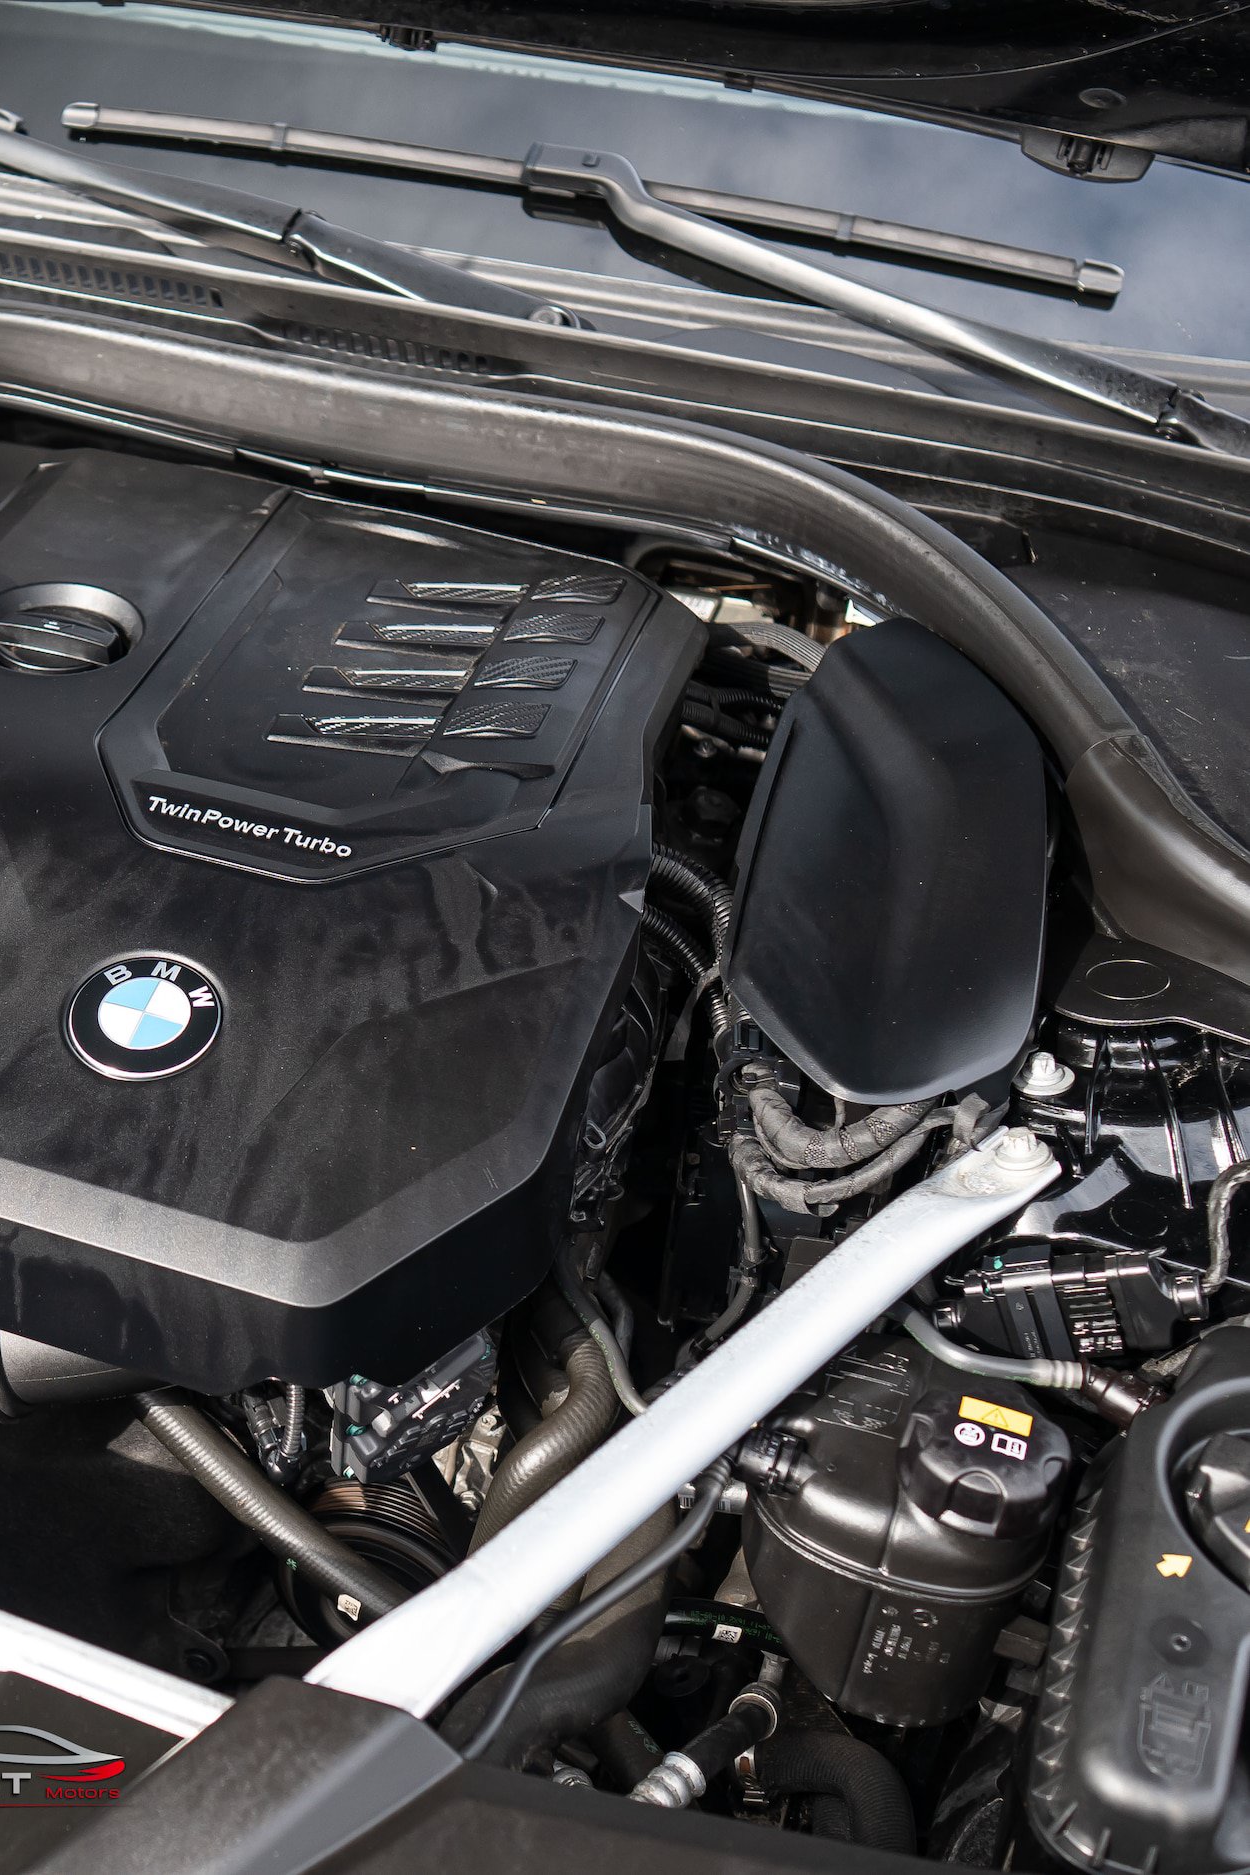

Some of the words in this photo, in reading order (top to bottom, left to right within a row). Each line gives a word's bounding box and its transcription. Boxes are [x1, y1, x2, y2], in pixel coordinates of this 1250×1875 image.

[149, 795, 280, 840] TwinPower
[281, 826, 353, 858] Turbo
[103, 960, 215, 1008] BMW
